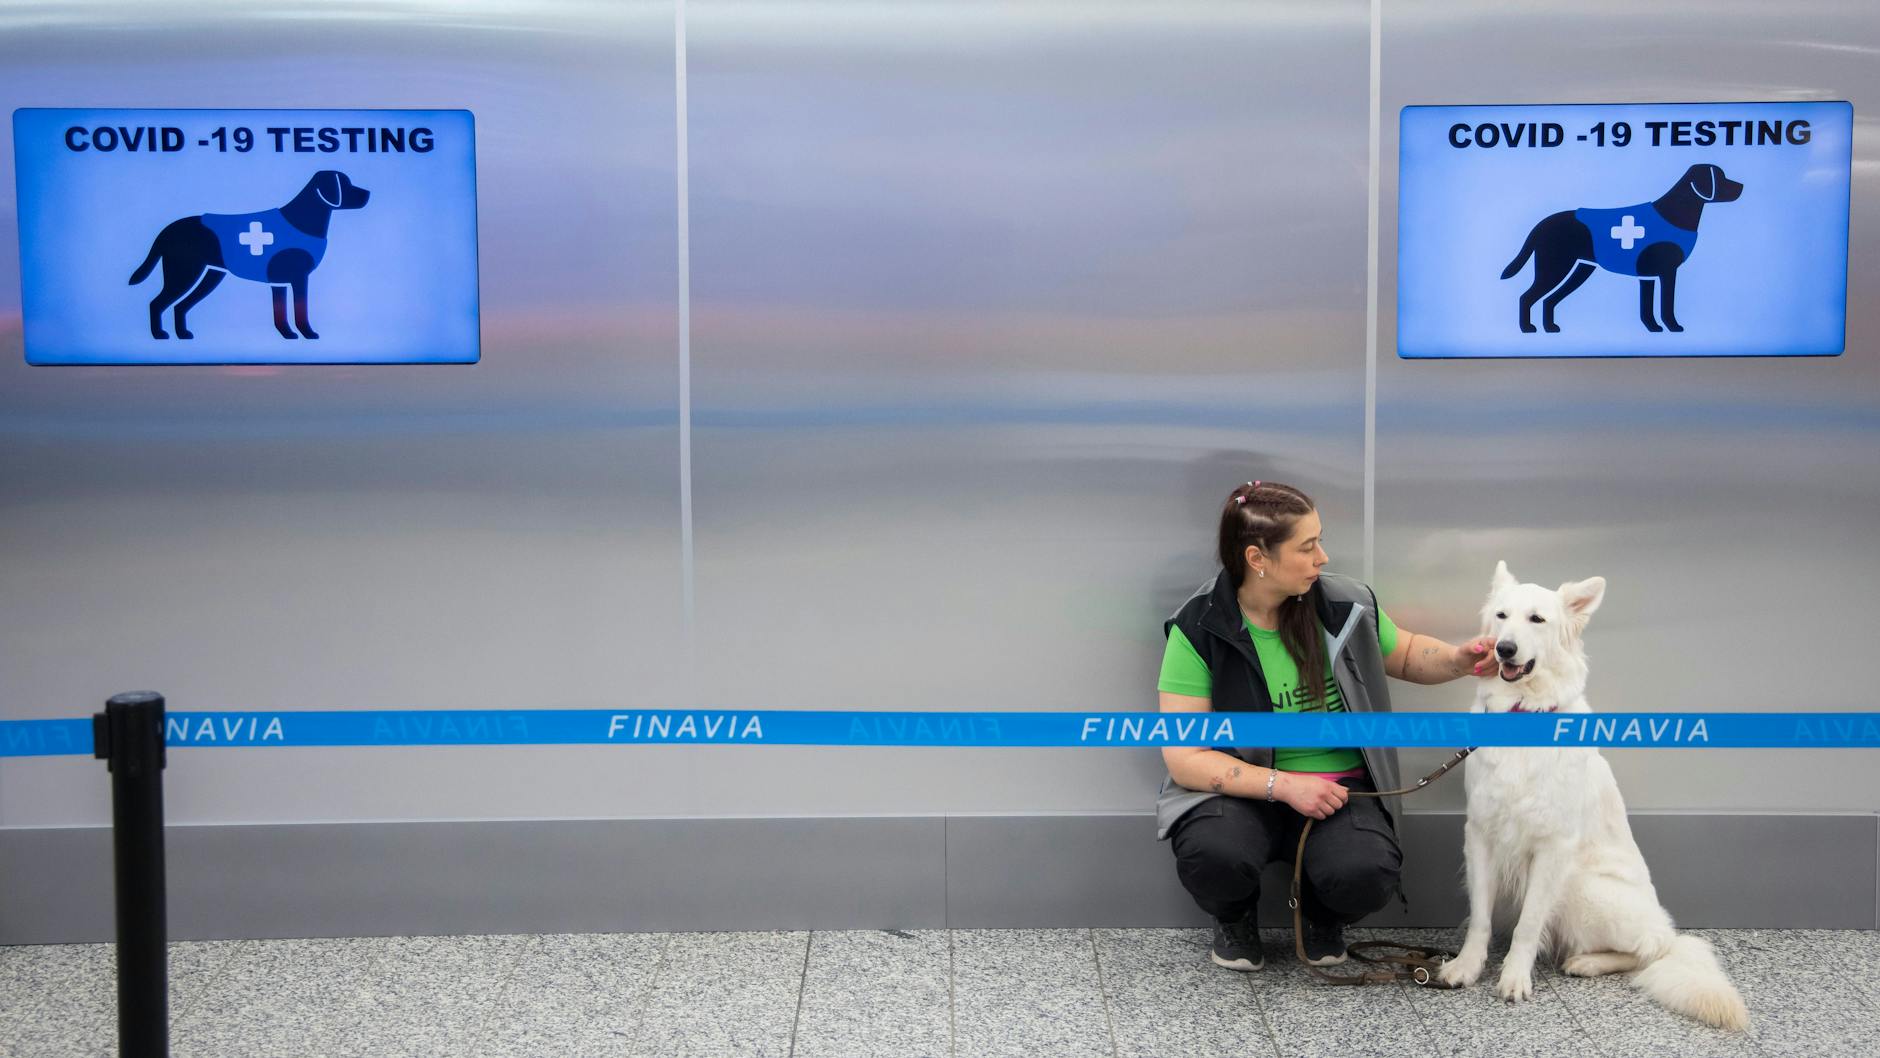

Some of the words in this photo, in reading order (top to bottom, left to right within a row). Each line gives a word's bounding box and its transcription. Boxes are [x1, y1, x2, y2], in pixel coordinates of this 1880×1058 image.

[65, 126, 184, 153] COVID
[198, 126, 254, 153] -19
[267, 127, 435, 154] TESTING
[1448, 122, 1565, 149] COVID
[1576, 121, 1632, 148] -19
[1644, 119, 1812, 147] TESTING
[167, 717, 284, 741] NAVIA
[607, 714, 764, 740] FINAVIA
[1081, 717, 1235, 741] FINAVIA
[1553, 718, 1709, 742] FINAVIA
